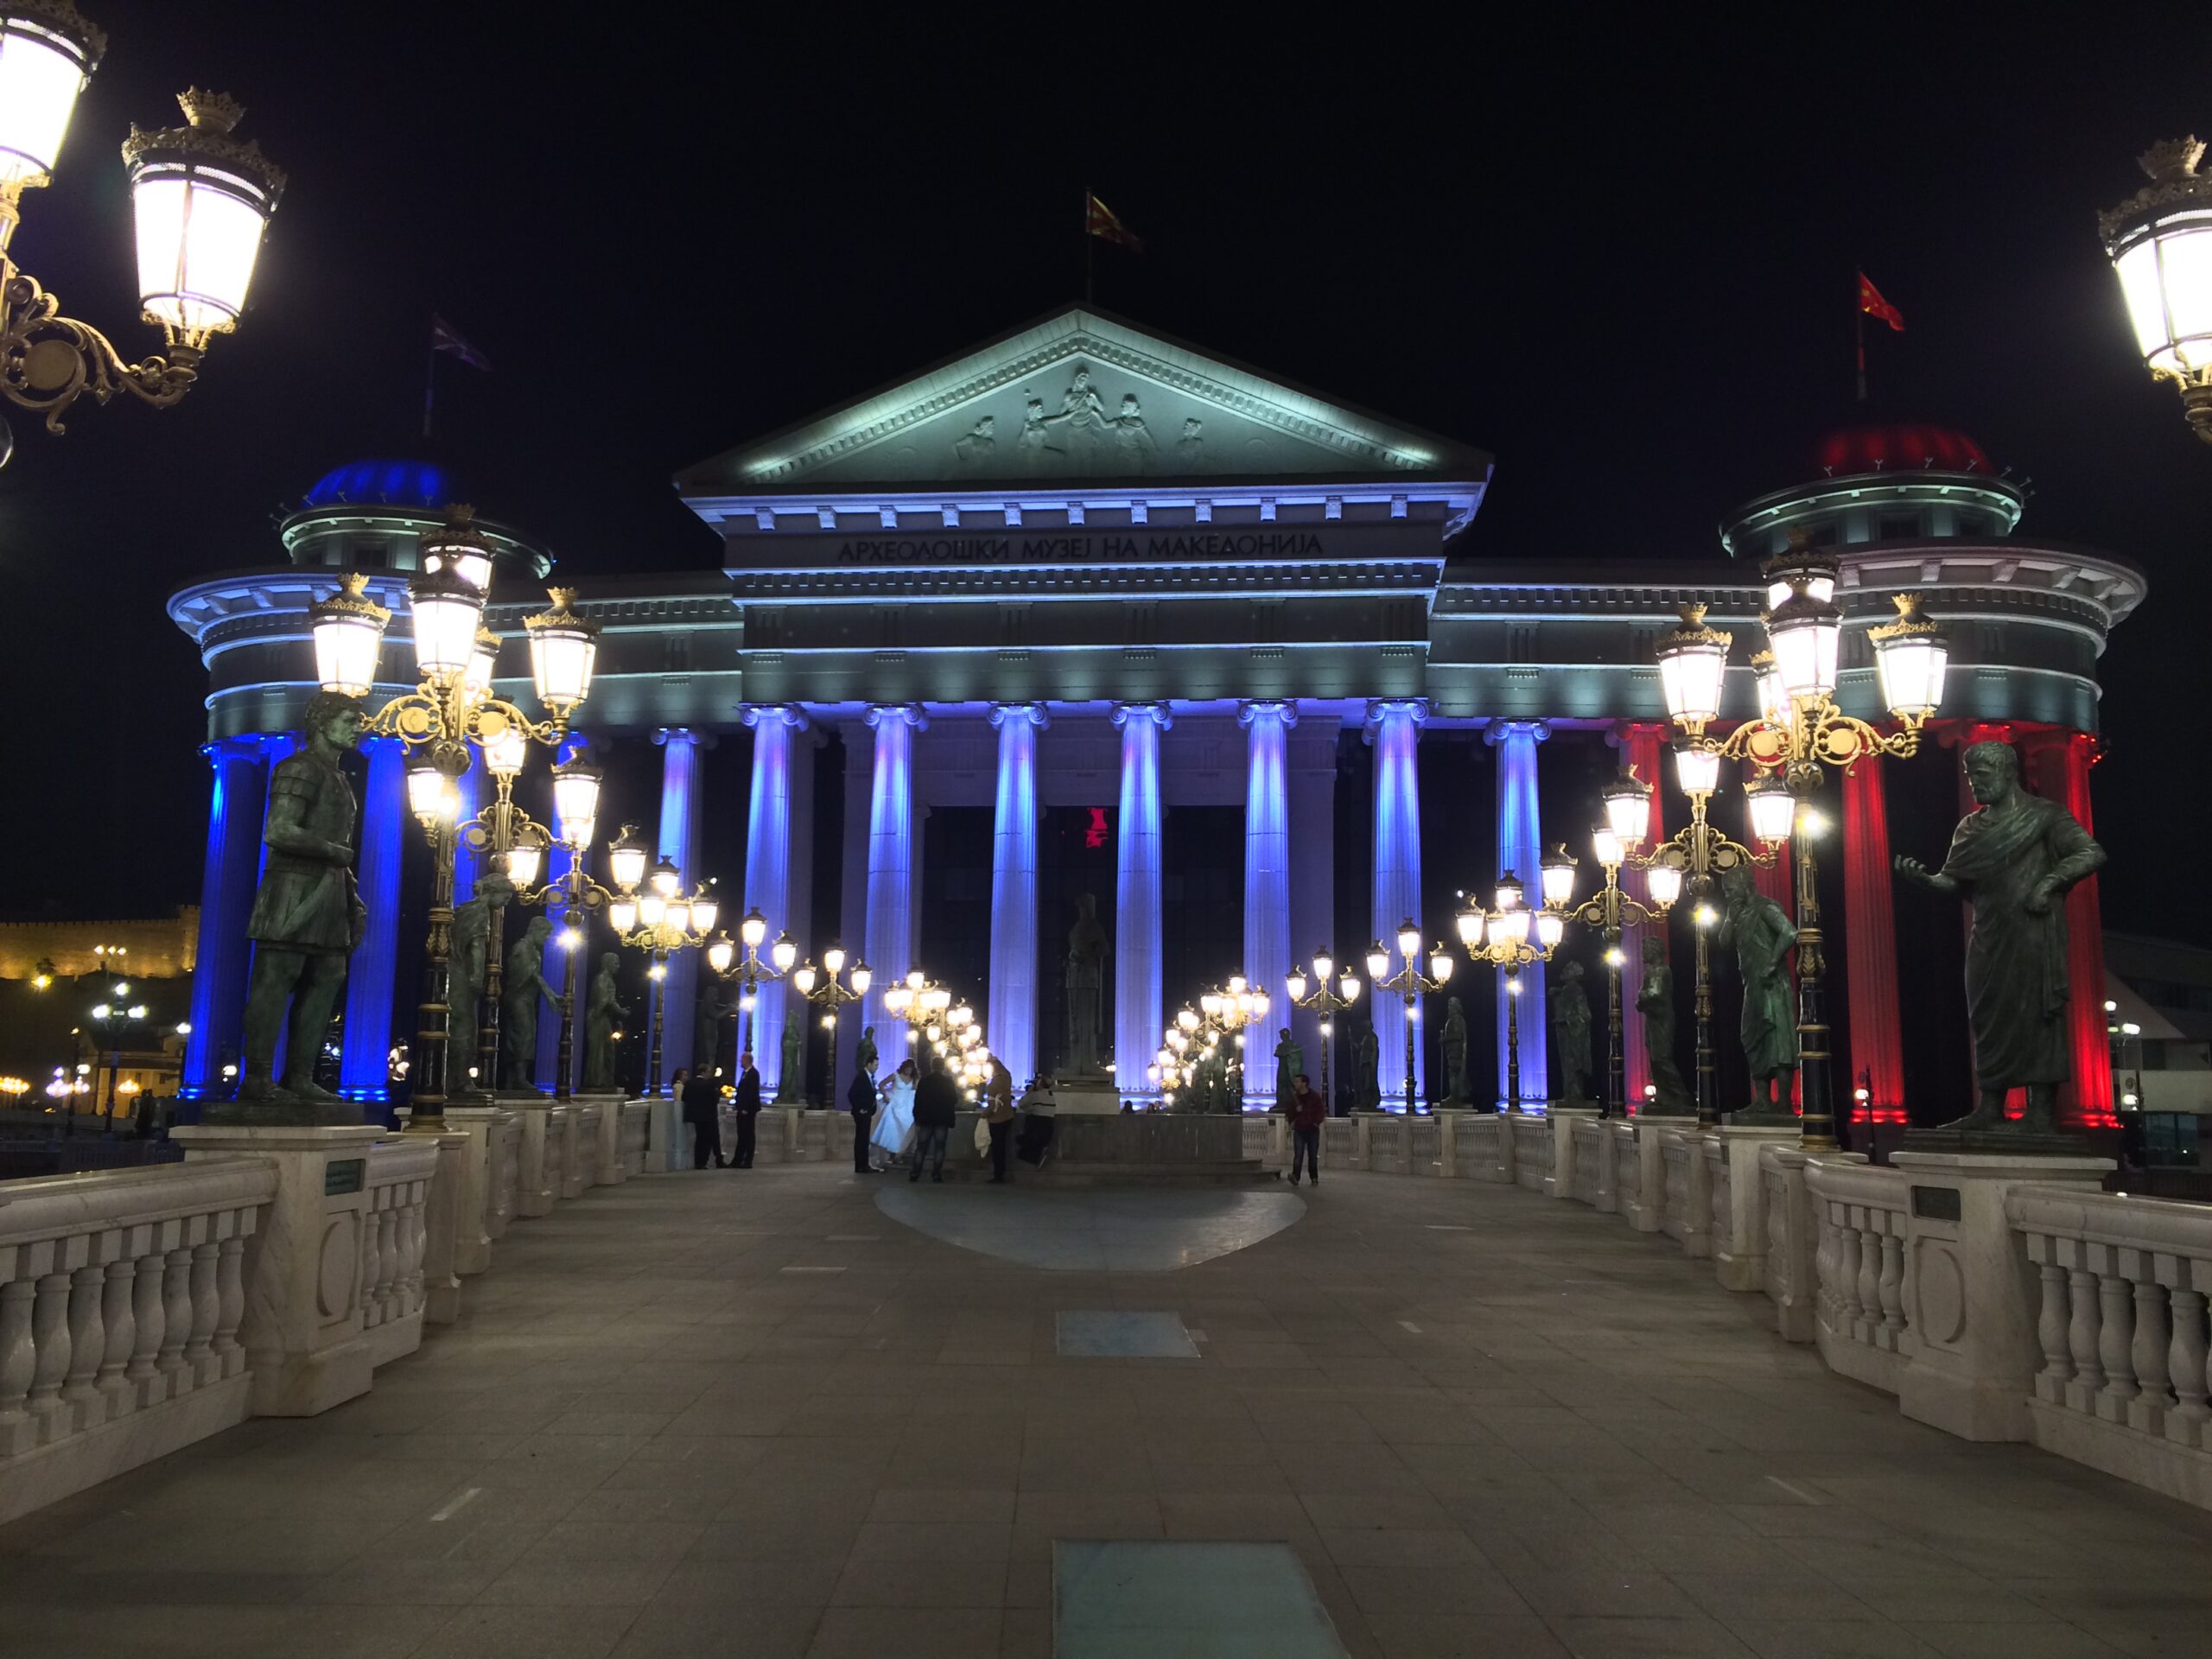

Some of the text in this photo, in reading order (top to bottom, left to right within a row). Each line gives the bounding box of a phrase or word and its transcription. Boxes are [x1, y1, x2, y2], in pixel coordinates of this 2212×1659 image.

[1021, 537, 1091, 559] МУЗЕЈ
[1103, 537, 1139, 557] НА
[1148, 533, 1323, 556] МАКЕДОНИЈА
